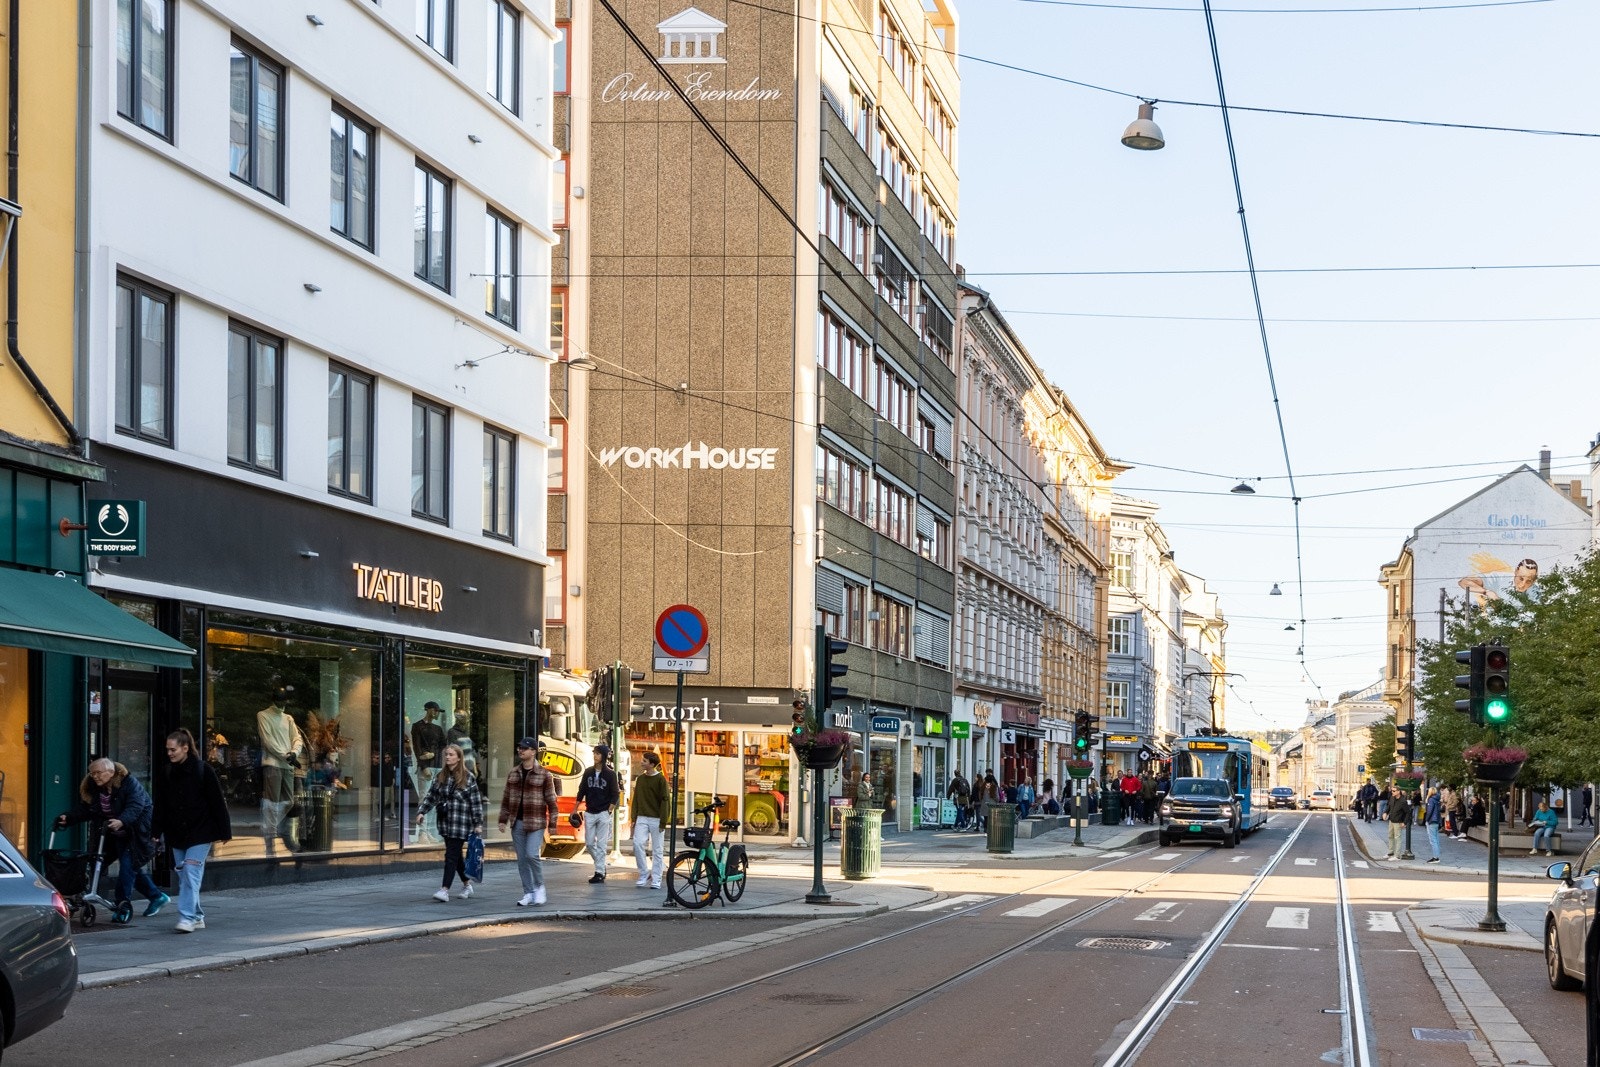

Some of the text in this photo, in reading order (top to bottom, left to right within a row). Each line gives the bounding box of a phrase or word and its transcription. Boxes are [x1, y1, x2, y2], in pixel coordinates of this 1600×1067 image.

[684, 71, 782, 102] Eiendom
[1487, 513, 1547, 527] Clas Ohlson
[352, 562, 444, 613] TATLER
[649, 697, 722, 722] norli
[835, 705, 853, 728] norli
[875, 720, 898, 729] norli
[587, 776, 607, 790] GAP
